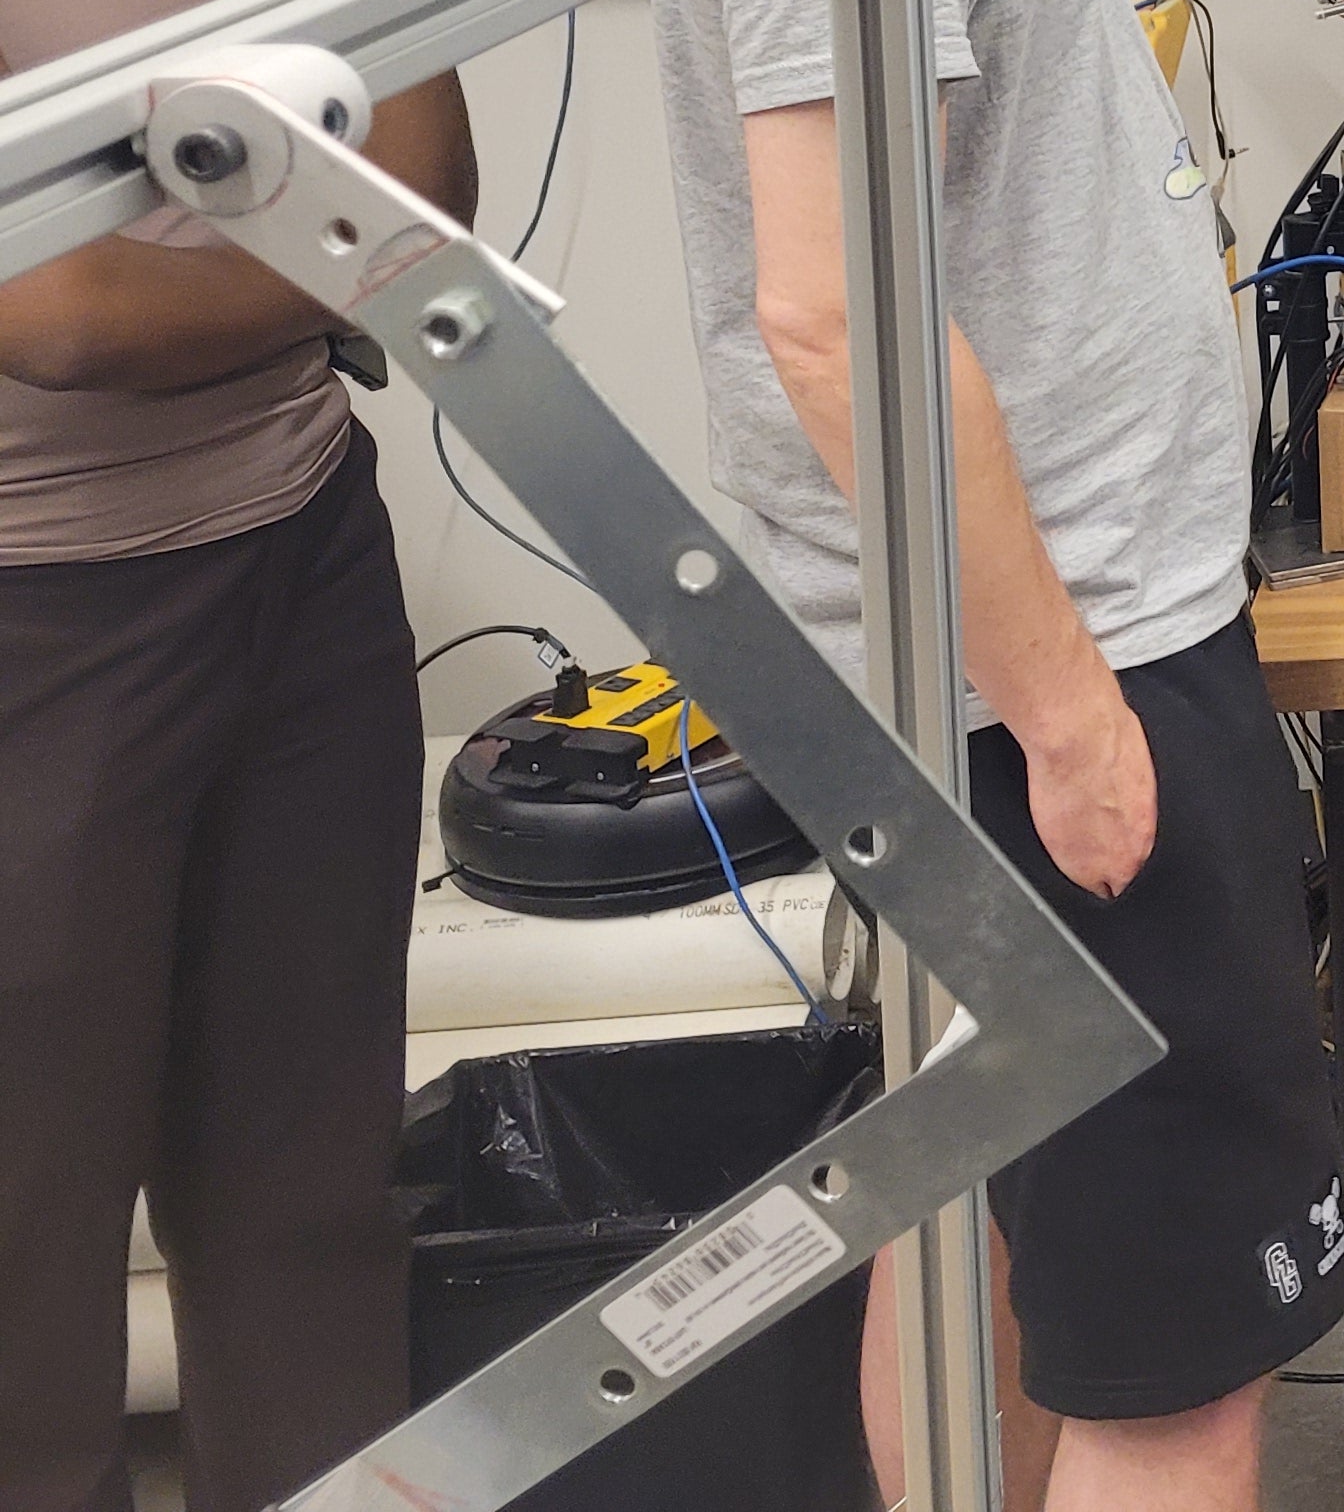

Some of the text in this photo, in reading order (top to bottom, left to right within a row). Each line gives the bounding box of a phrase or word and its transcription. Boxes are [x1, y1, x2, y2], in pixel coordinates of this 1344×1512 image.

[723, 901, 742, 916] SD
[757, 900, 774, 914] 35
[782, 898, 809, 912] PVC
